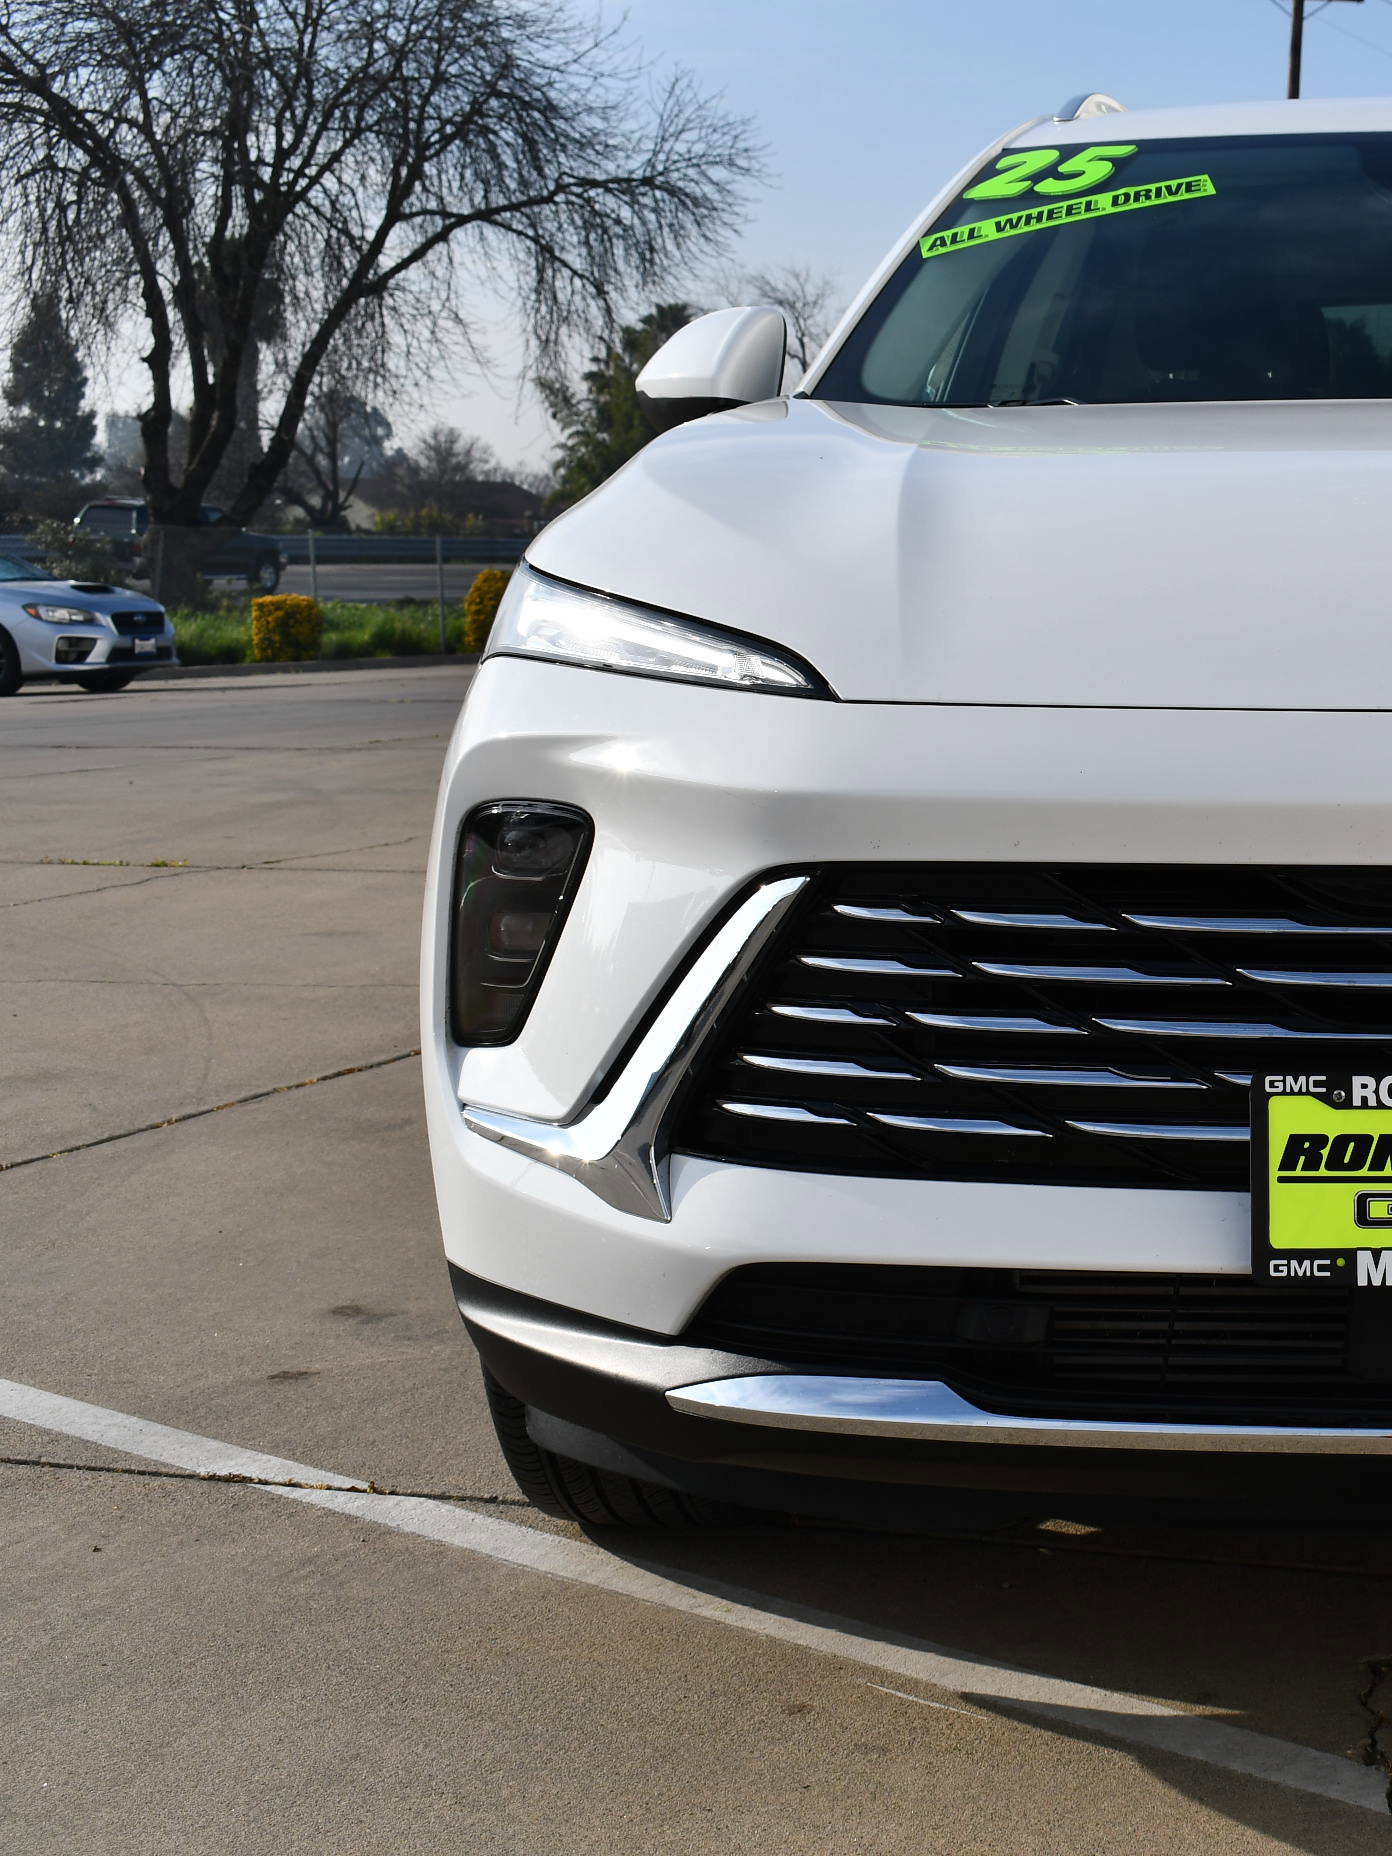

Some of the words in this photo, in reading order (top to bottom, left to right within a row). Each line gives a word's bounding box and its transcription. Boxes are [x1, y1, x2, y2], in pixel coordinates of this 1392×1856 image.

[963, 145, 1138, 200] 25
[926, 226, 985, 252] ALL
[994, 200, 1103, 233] WHEEL
[1112, 178, 1203, 207] DRIVE
[1264, 1075, 1327, 1093] GMC
[1269, 1259, 1331, 1277] GMC
